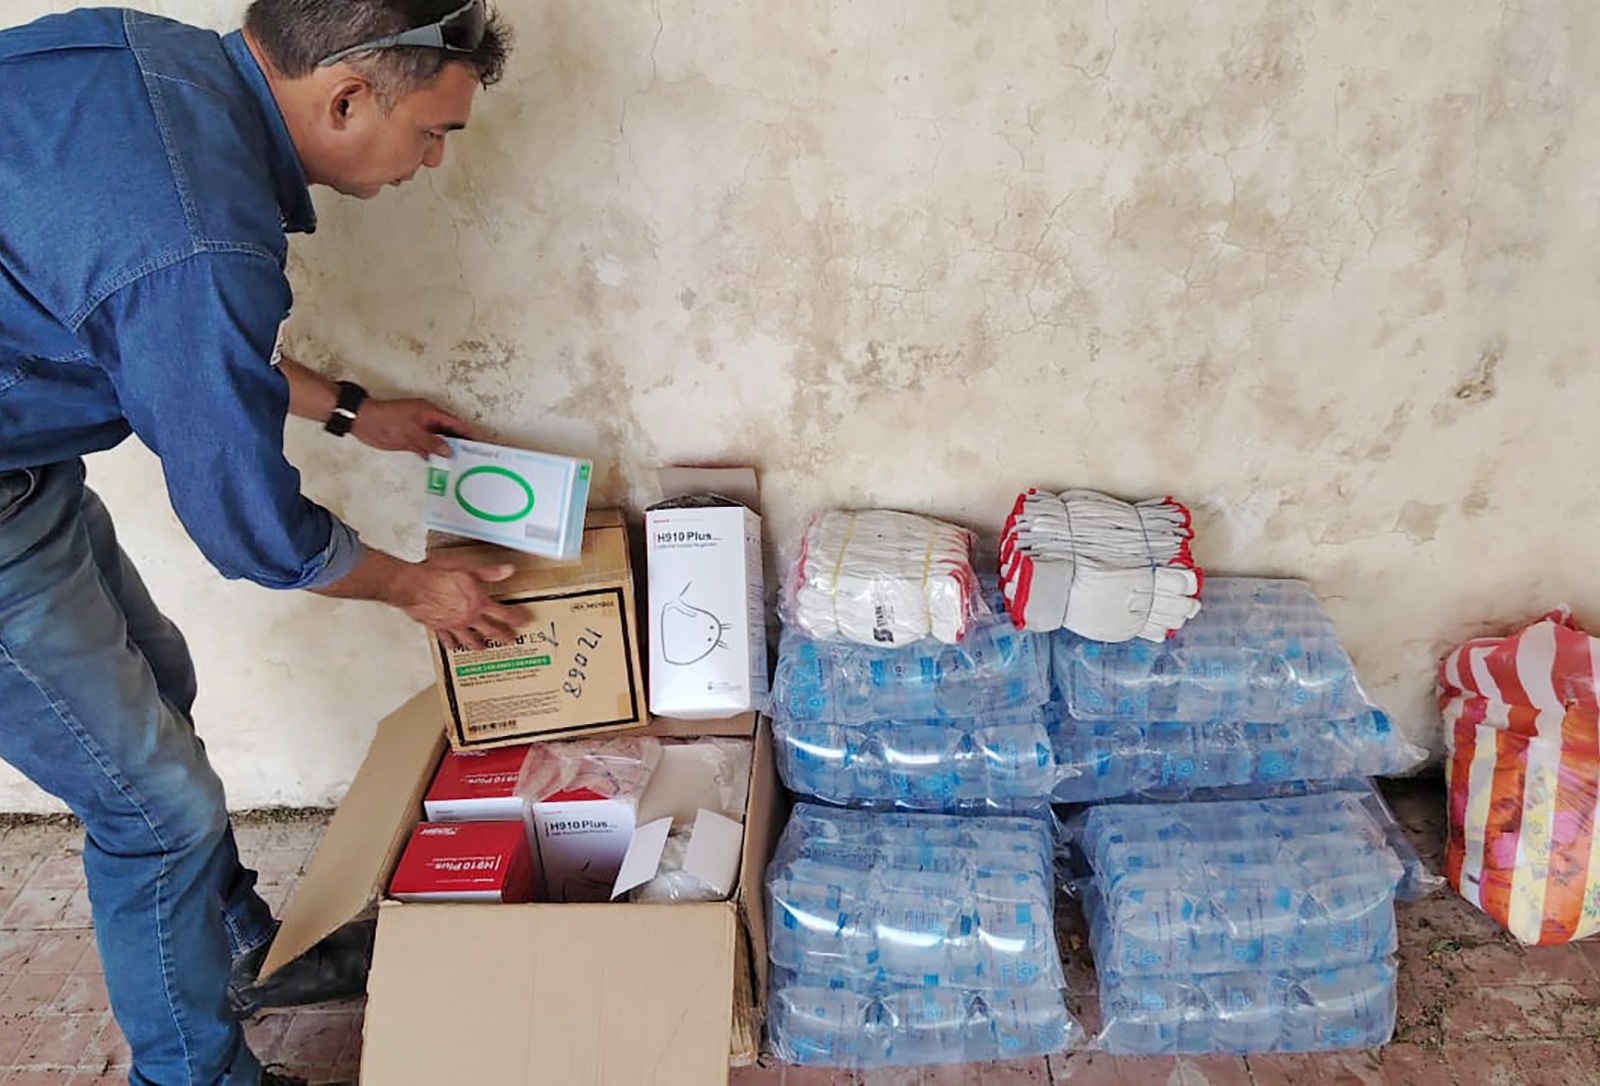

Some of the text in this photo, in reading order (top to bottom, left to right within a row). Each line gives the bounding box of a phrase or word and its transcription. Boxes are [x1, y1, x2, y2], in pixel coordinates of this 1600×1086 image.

[657, 531, 712, 543] H910 Plus
[550, 820, 608, 830] H910 Plus
[435, 860, 494, 871] H910 Plus
